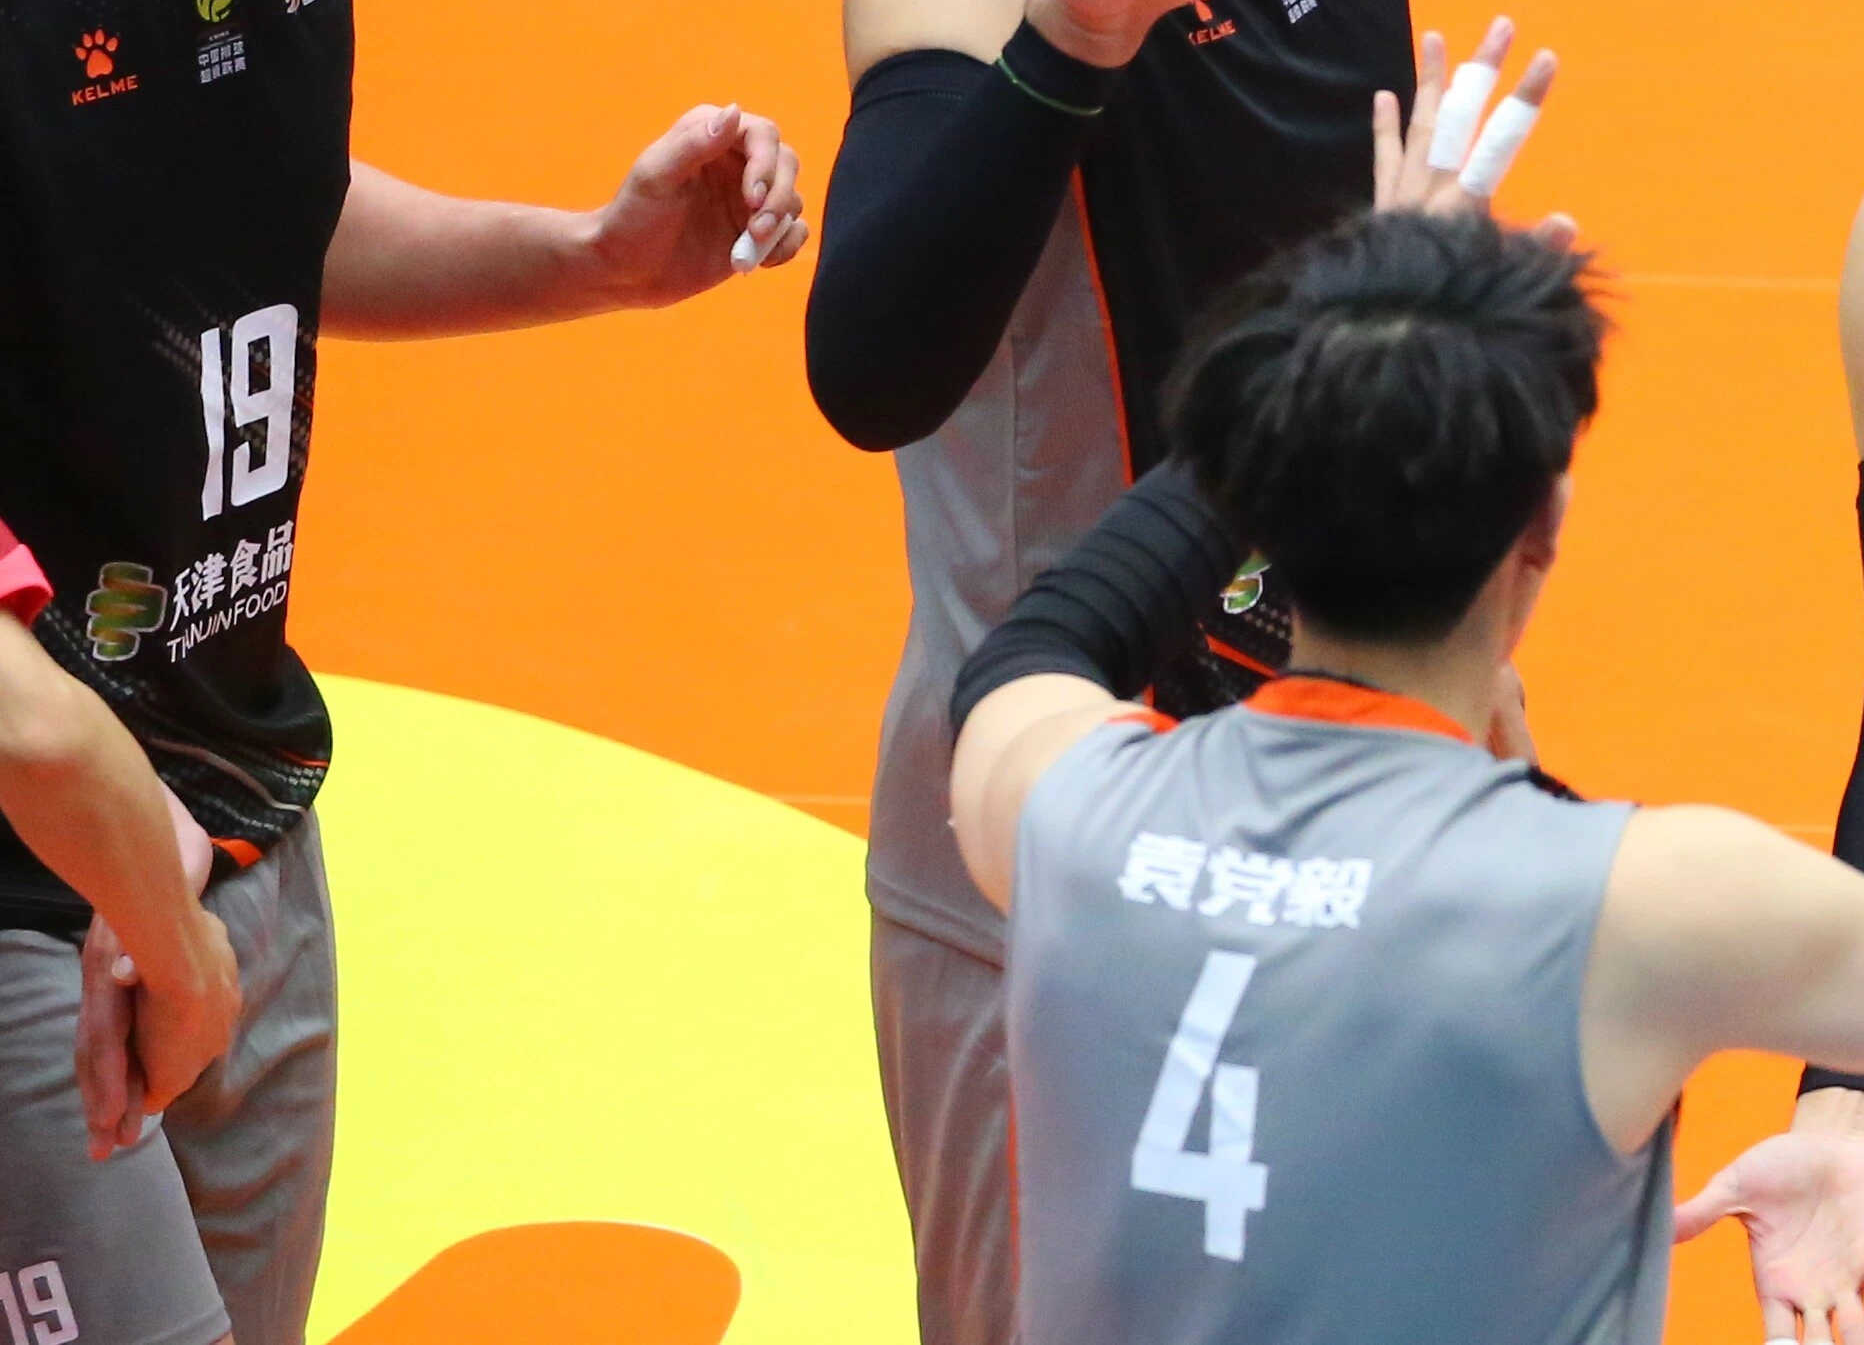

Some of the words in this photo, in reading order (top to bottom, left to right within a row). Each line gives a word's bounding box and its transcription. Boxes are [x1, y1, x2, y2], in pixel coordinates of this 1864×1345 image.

[71, 75, 140, 106] KELME
[201, 303, 298, 521] 19
[167, 608, 232, 663] TIANJIN
[233, 581, 288, 627] FOOD
[169, 520, 294, 632] 天津食品
[1131, 950, 1269, 1262] 4
[0, 1259, 79, 1345] 19
